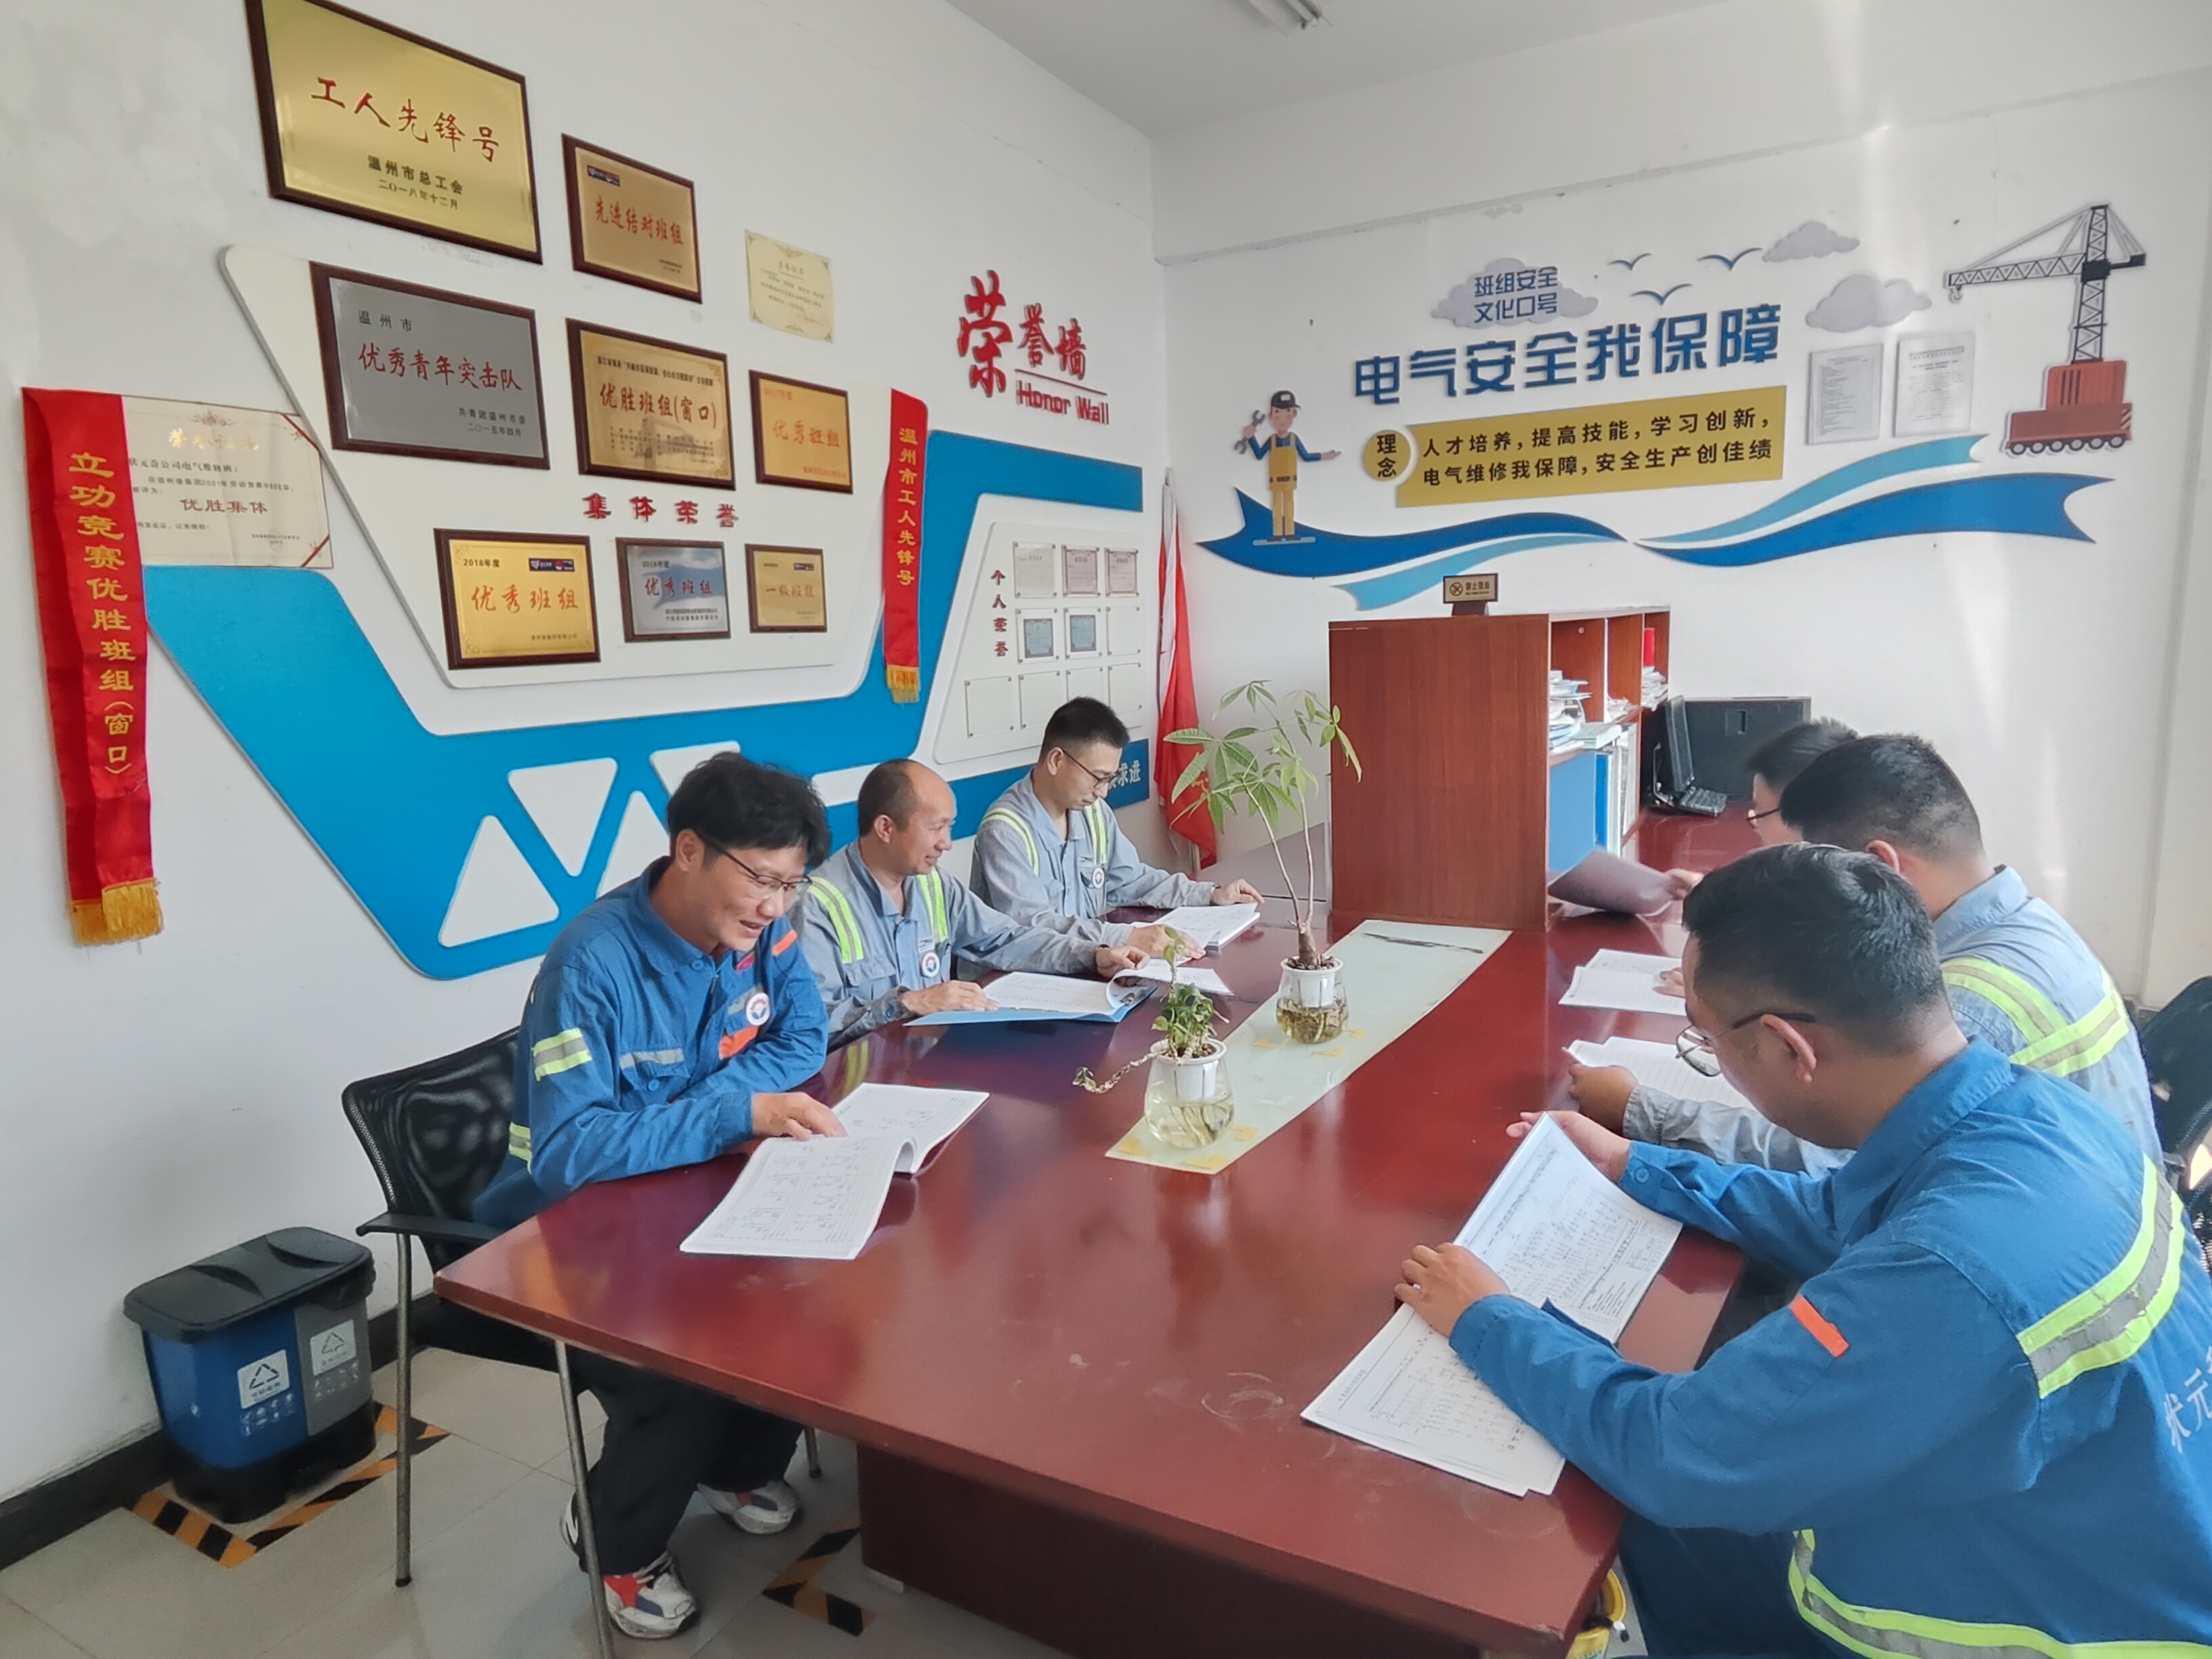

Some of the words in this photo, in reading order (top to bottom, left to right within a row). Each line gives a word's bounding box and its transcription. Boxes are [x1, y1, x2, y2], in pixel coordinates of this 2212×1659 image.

[310, 77, 499, 163] 工人先锋号
[367, 155, 464, 195] 温州市总工会
[595, 194, 684, 245] 先进结对班组
[1474, 266, 1558, 298] 班组安全
[357, 309, 413, 333] 温州市
[1474, 292, 1557, 324] 文化口号
[956, 269, 1087, 398] 荣誉墙
[358, 342, 523, 392] 优秀青年突击队
[1354, 303, 1781, 406] 电气安全我保障
[458, 407, 526, 425] 共青团温州市委
[1016, 380, 1071, 415] Honor
[1075, 395, 1110, 425] Wall
[772, 419, 841, 448] 优秀班组
[1376, 434, 1397, 478] 理念
[180, 498, 268, 515] 优胜集体
[581, 493, 739, 528] 集体荣誉
[896, 428, 919, 586] 温州市工人先锋号
[463, 558, 500, 568] 2018年度
[471, 583, 579, 613] 优秀班组
[644, 576, 713, 598] 优秀班组
[990, 569, 1009, 657] 个人荣誉
[2164, 1345, 2212, 1454] 状元
